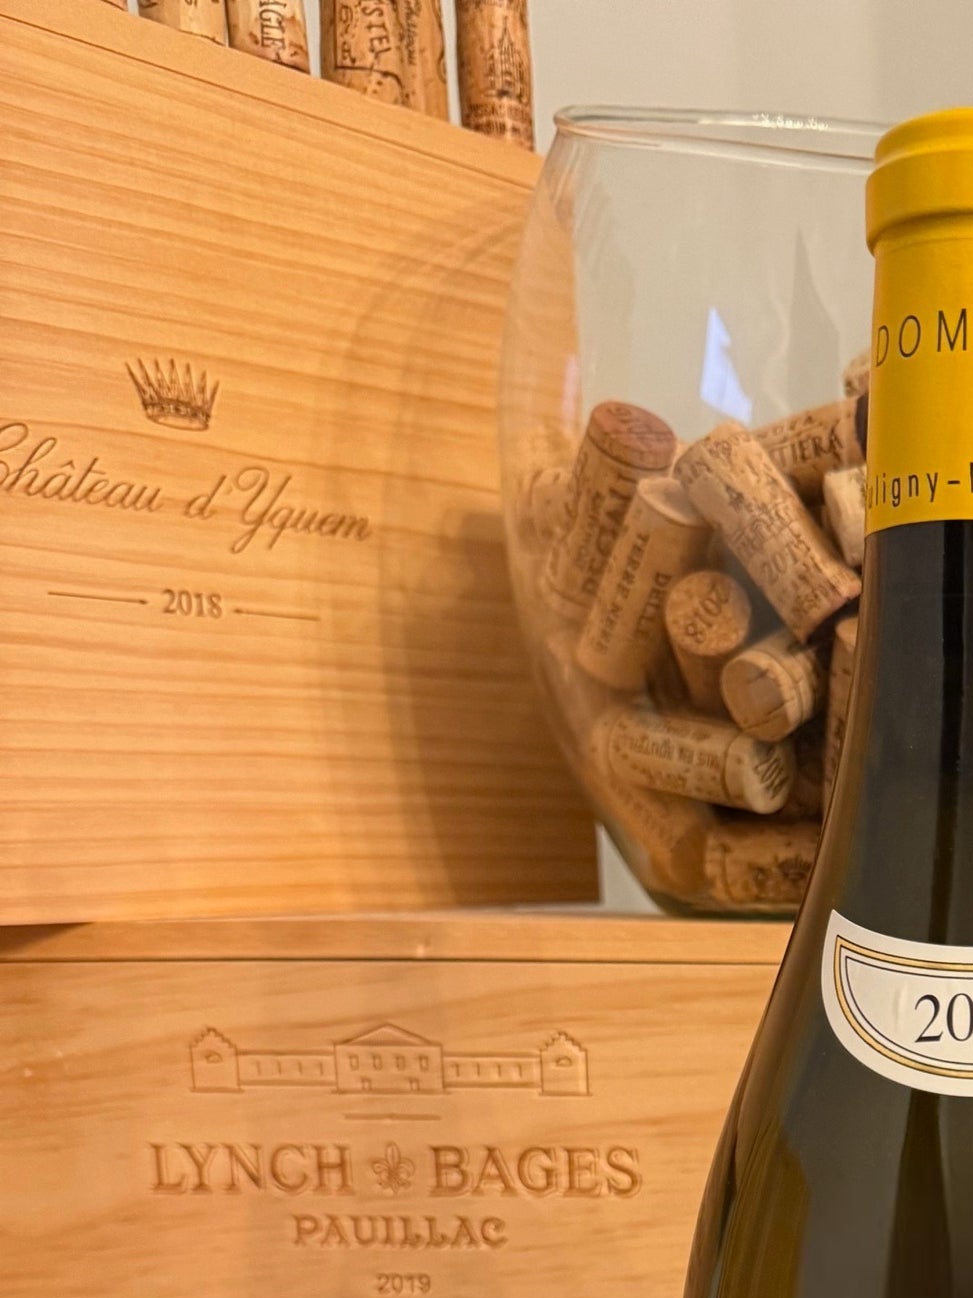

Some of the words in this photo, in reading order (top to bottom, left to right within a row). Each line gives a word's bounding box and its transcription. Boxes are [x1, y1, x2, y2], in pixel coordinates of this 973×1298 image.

[183, 465, 373, 554] d'Yquem
[162, 588, 224, 618] 2018
[147, 1140, 355, 1196] LYNCH
[427, 1142, 643, 1198] BAGES
[291, 1213, 509, 1250] PAUILLAC
[376, 1271, 432, 1295] 2019
